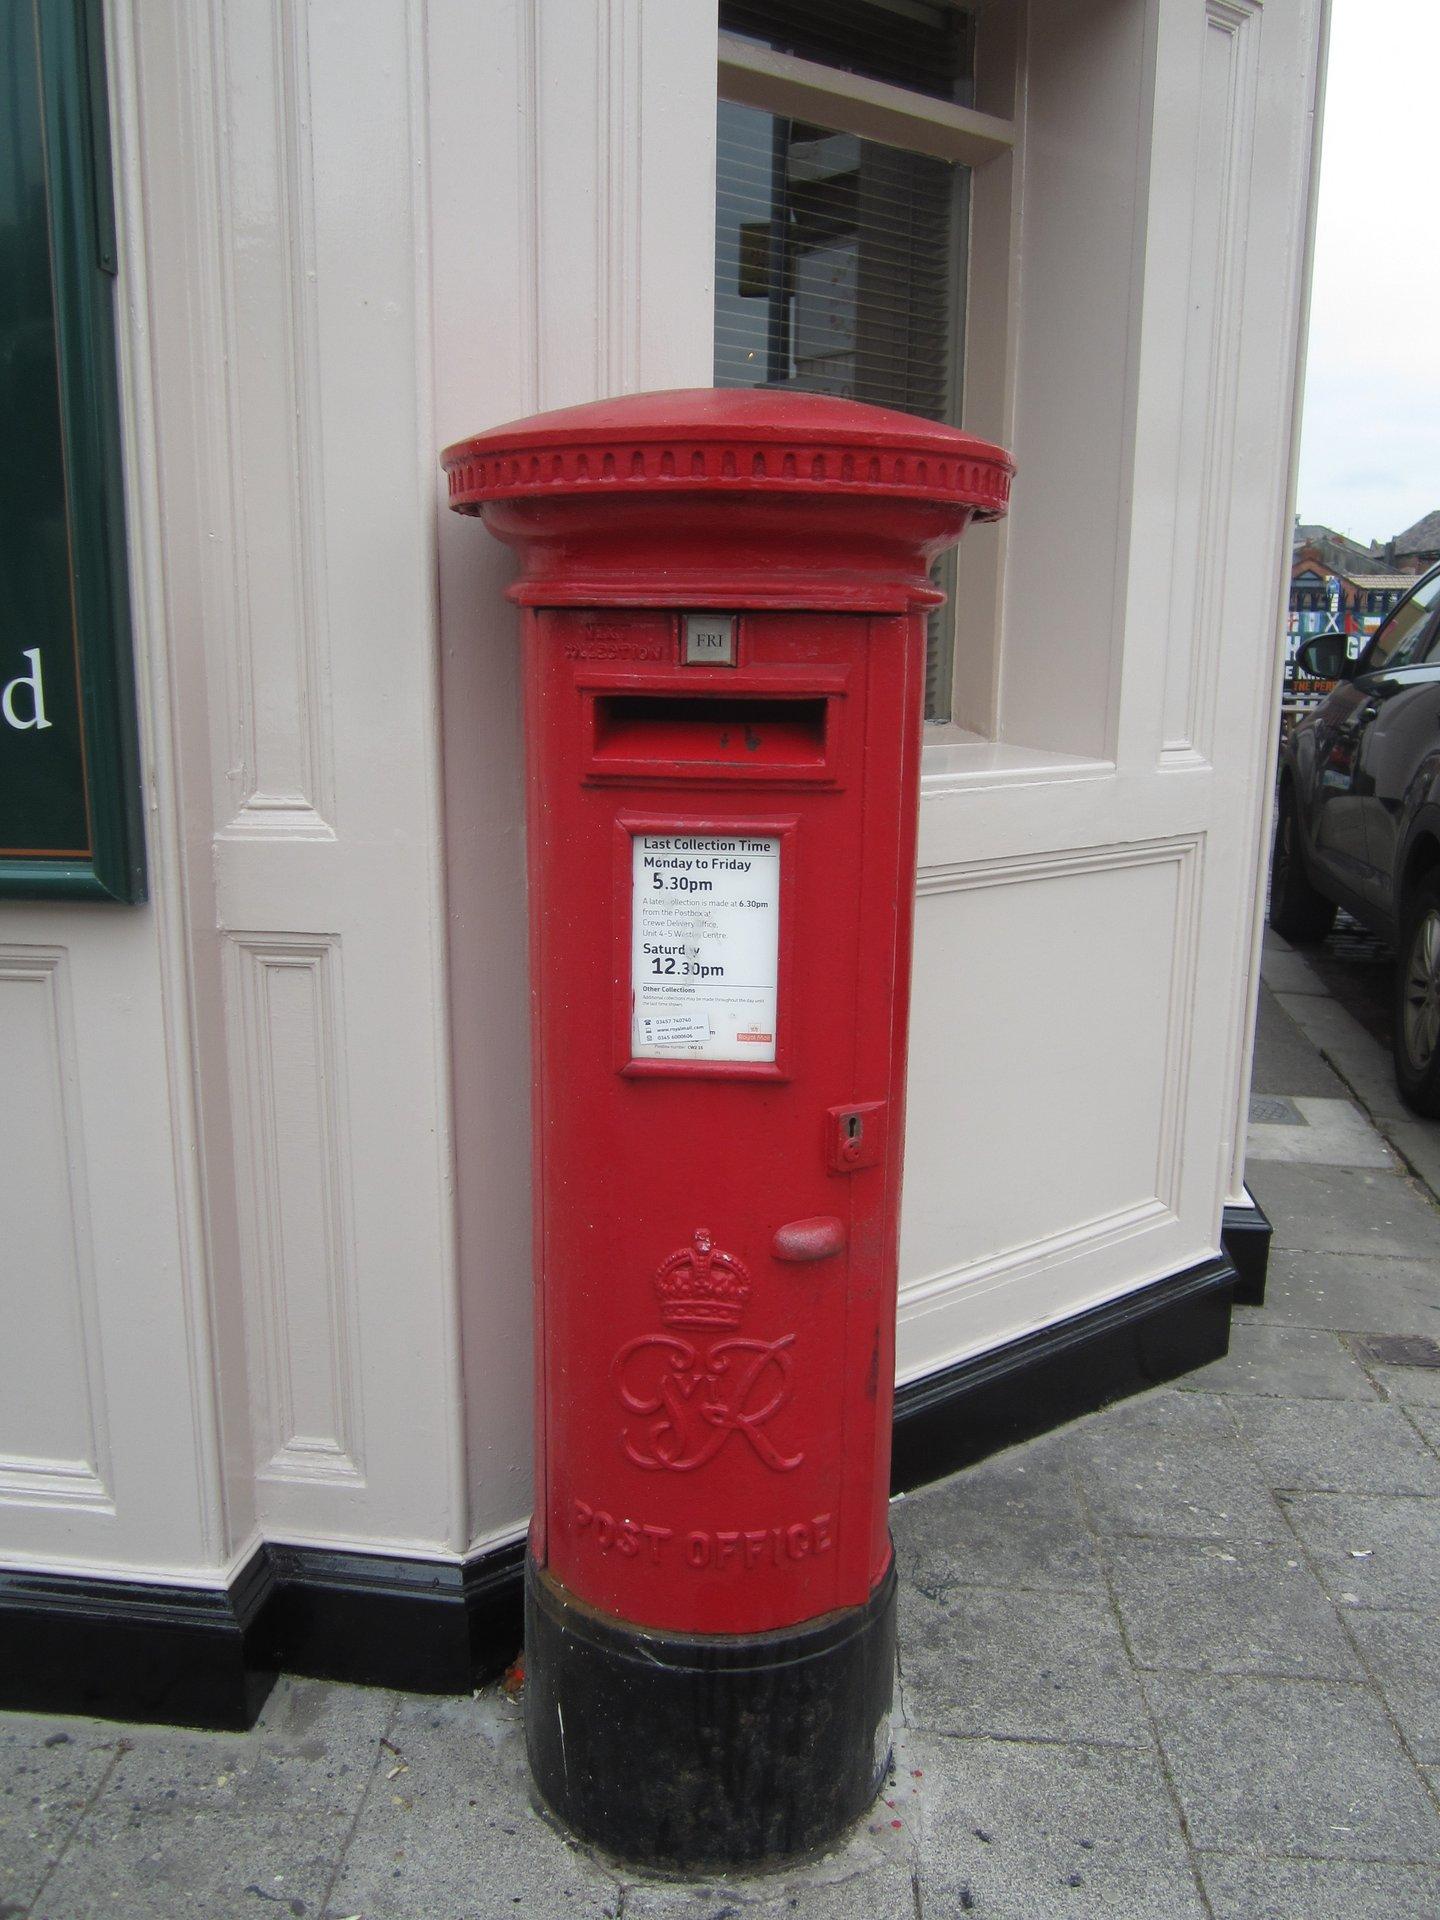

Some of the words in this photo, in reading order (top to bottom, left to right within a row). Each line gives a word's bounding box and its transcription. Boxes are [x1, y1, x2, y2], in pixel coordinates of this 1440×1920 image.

[697, 634, 723, 648] FRI
[644, 838, 671, 850] Last
[674, 838, 736, 851] Collection
[738, 840, 771, 852] Time
[643, 857, 693, 871] Monday
[696, 858, 708, 870] to
[711, 858, 752, 872] Friday
[652, 872, 713, 893] 5.30pm
[642, 897, 648, 905] A
[668, 898, 700, 906] ollection
[708, 899, 729, 907] made
[730, 900, 738, 908] at
[739, 900, 769, 909] 6.30pm
[674, 909, 703, 917] Postbox
[642, 919, 665, 927] Crewe
[666, 919, 694, 928] Delivery
[642, 929, 657, 937] Unit
[643, 942, 700, 958] Saturdy
[651, 957, 724, 978] 12.30pm
[642, 985, 661, 993] Other
[661, 986, 696, 994] Collections
[574, 1499, 673, 1565] POST
[687, 1512, 832, 1569] OFFICE
